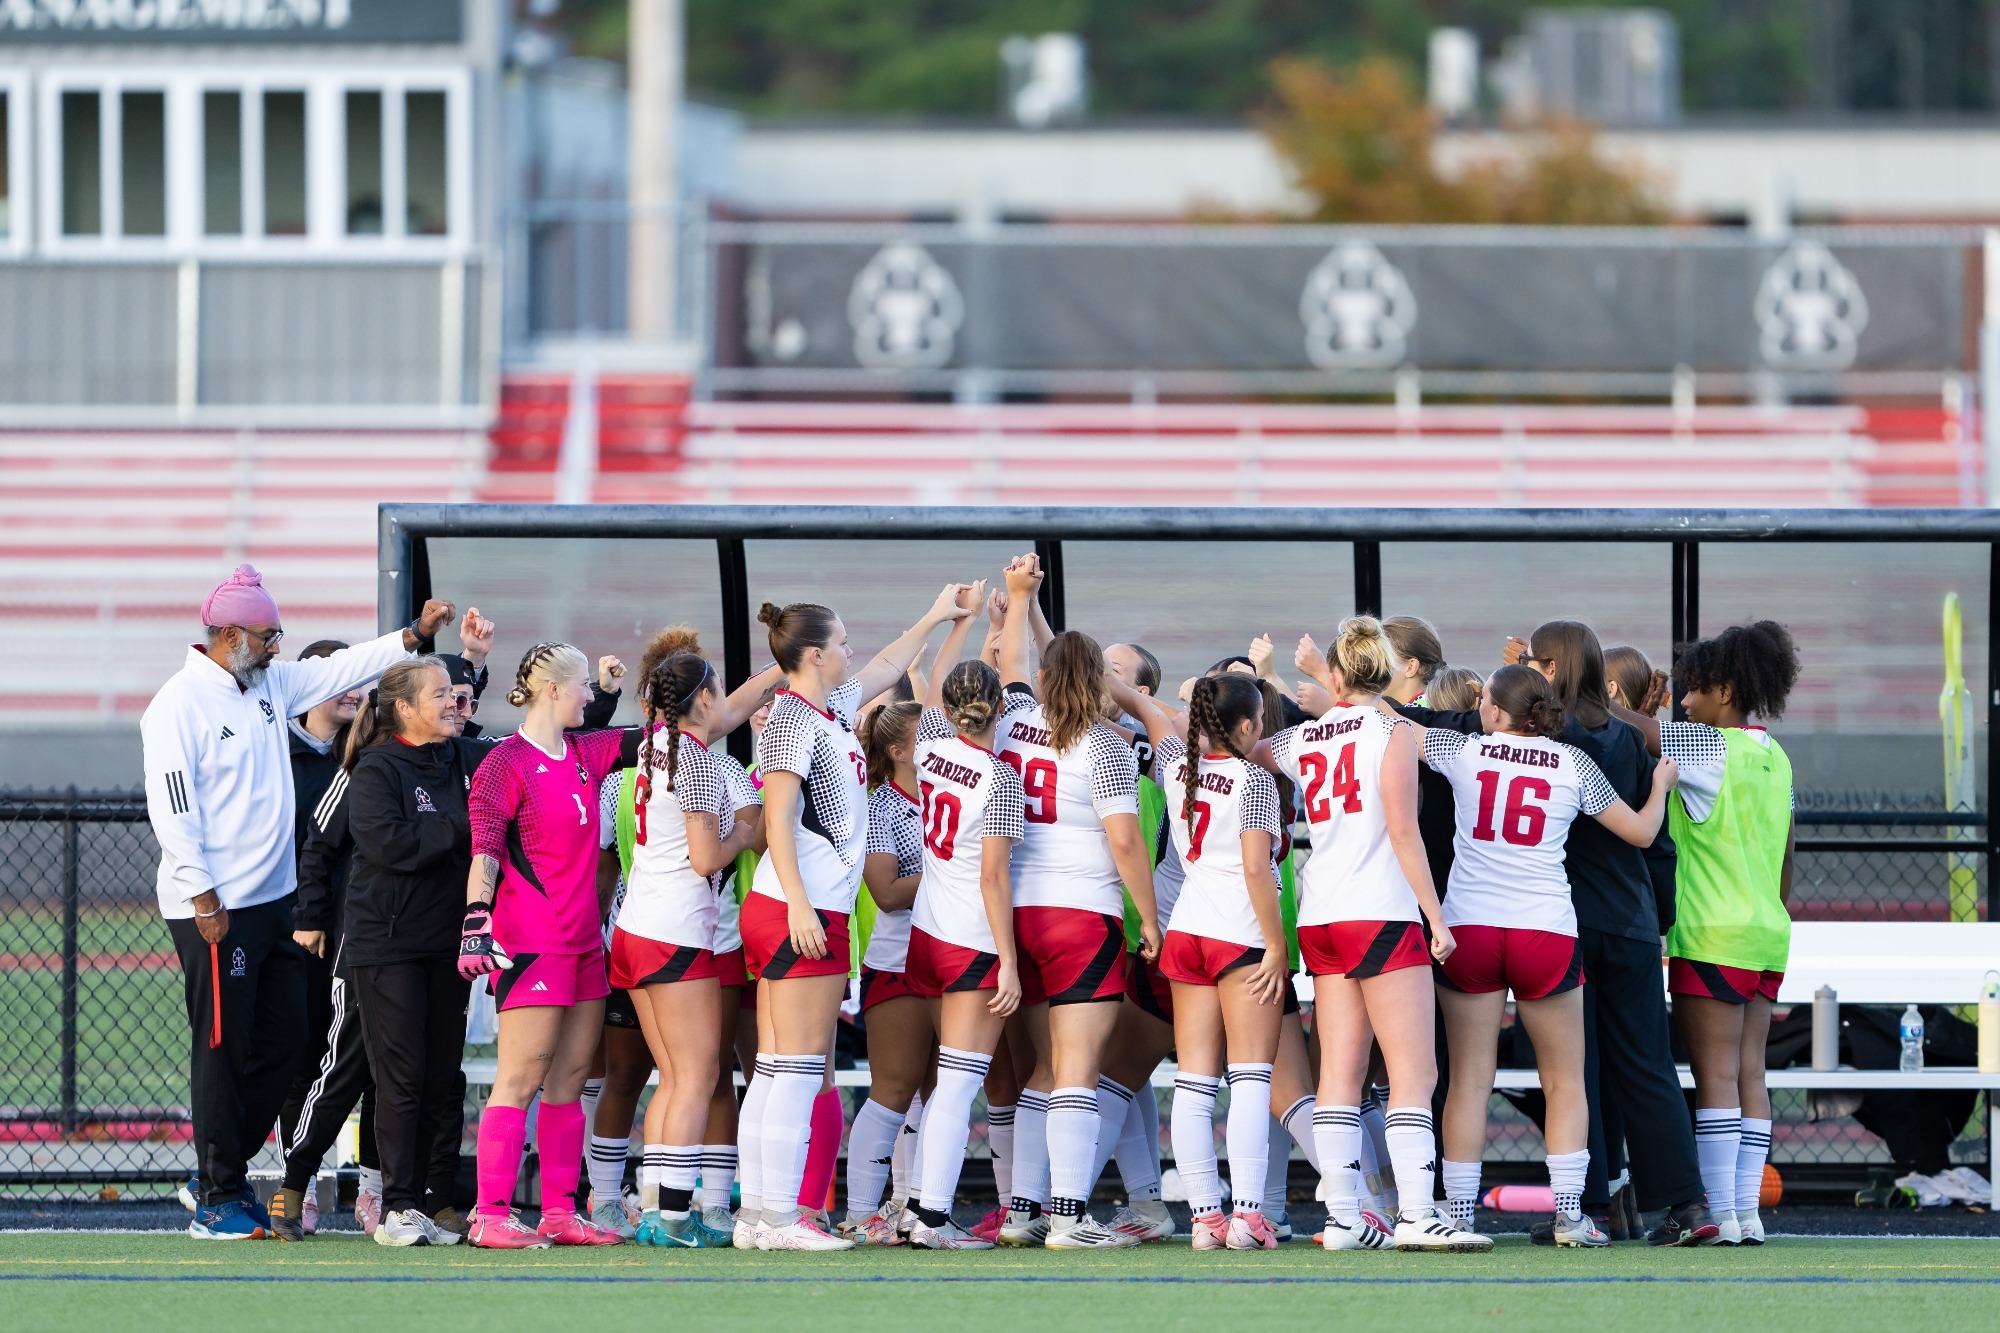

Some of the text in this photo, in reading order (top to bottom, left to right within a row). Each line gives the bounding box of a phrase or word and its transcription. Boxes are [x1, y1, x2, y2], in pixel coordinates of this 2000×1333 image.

[1008, 721, 1052, 748] TERRIE
[1480, 744, 1559, 769] TERRIERS
[921, 752, 982, 789] TERRIERS
[1299, 741, 1363, 824] 24
[572, 793, 588, 825] 1
[920, 780, 962, 861] 10
[1180, 799, 1210, 864] 7
[1472, 770, 1551, 847] 16
